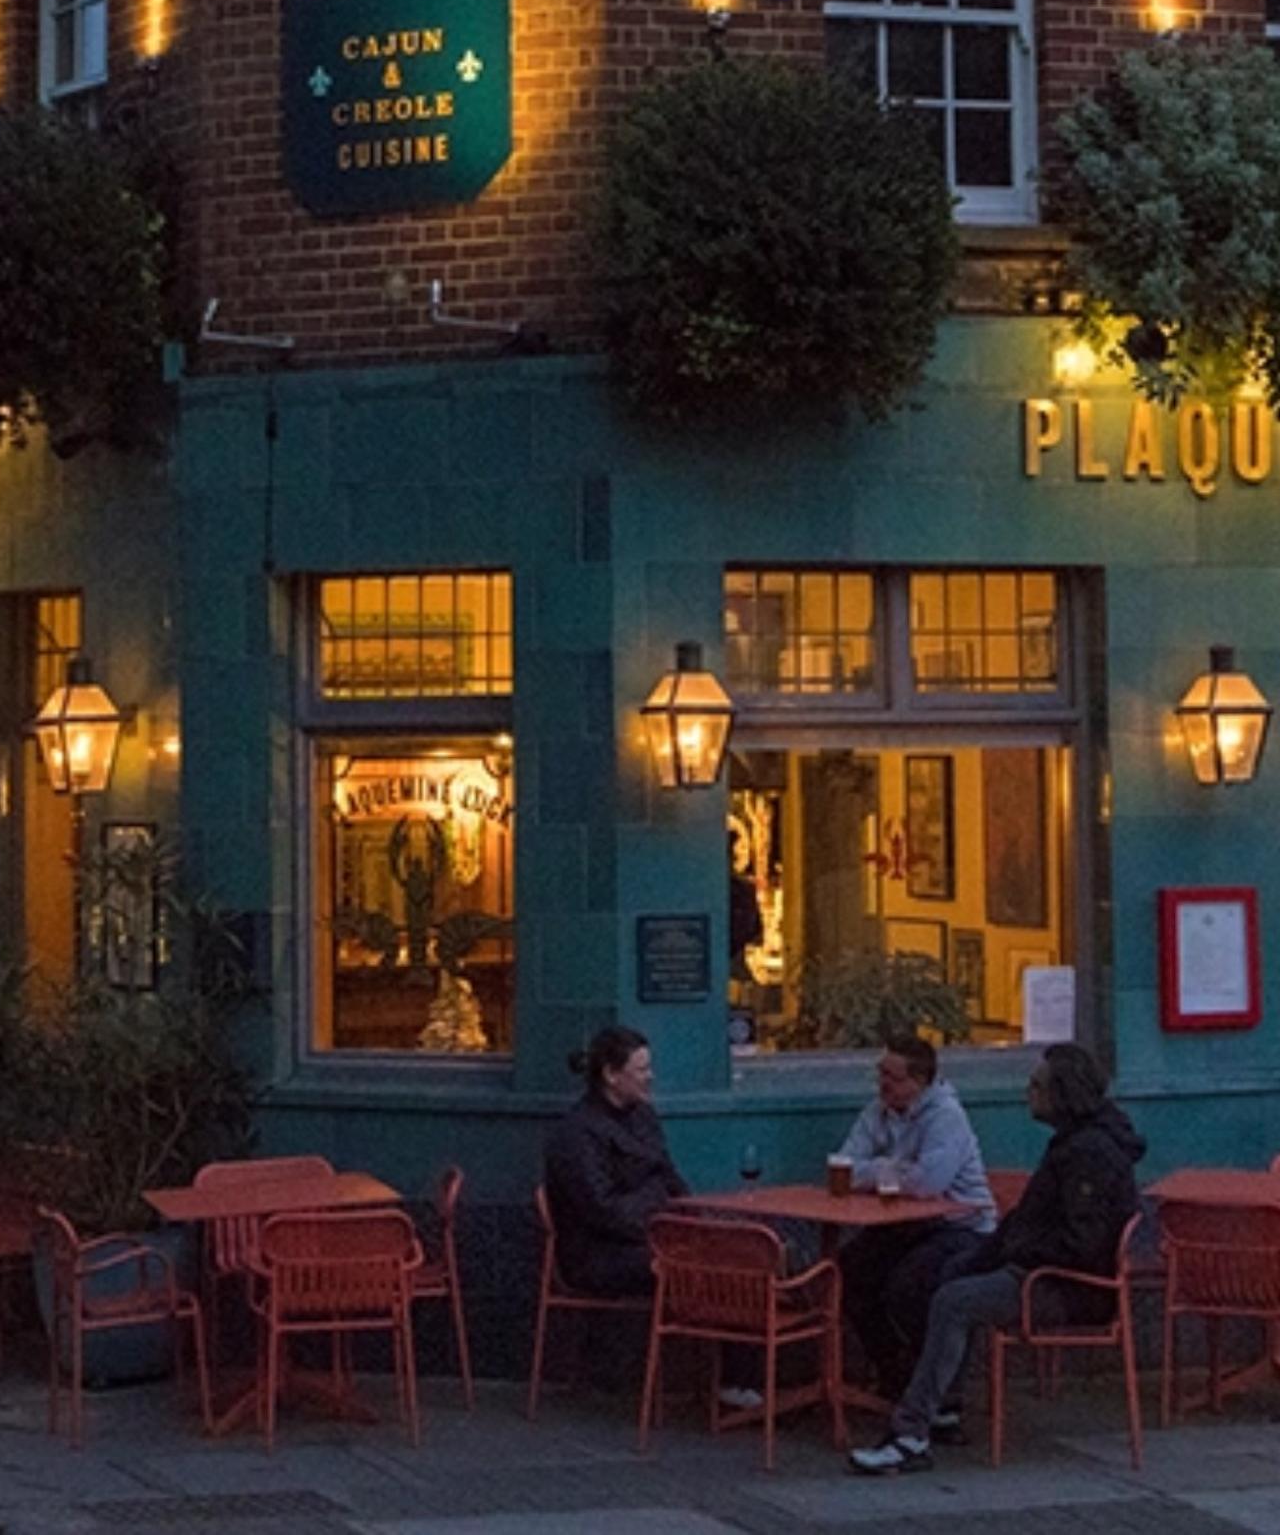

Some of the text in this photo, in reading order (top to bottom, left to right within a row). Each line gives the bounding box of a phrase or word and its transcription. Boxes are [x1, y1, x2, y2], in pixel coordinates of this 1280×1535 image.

[341, 28, 443, 60] CAJUN
[331, 91, 454, 126] CREOLE
[337, 132, 449, 170] CUISINE
